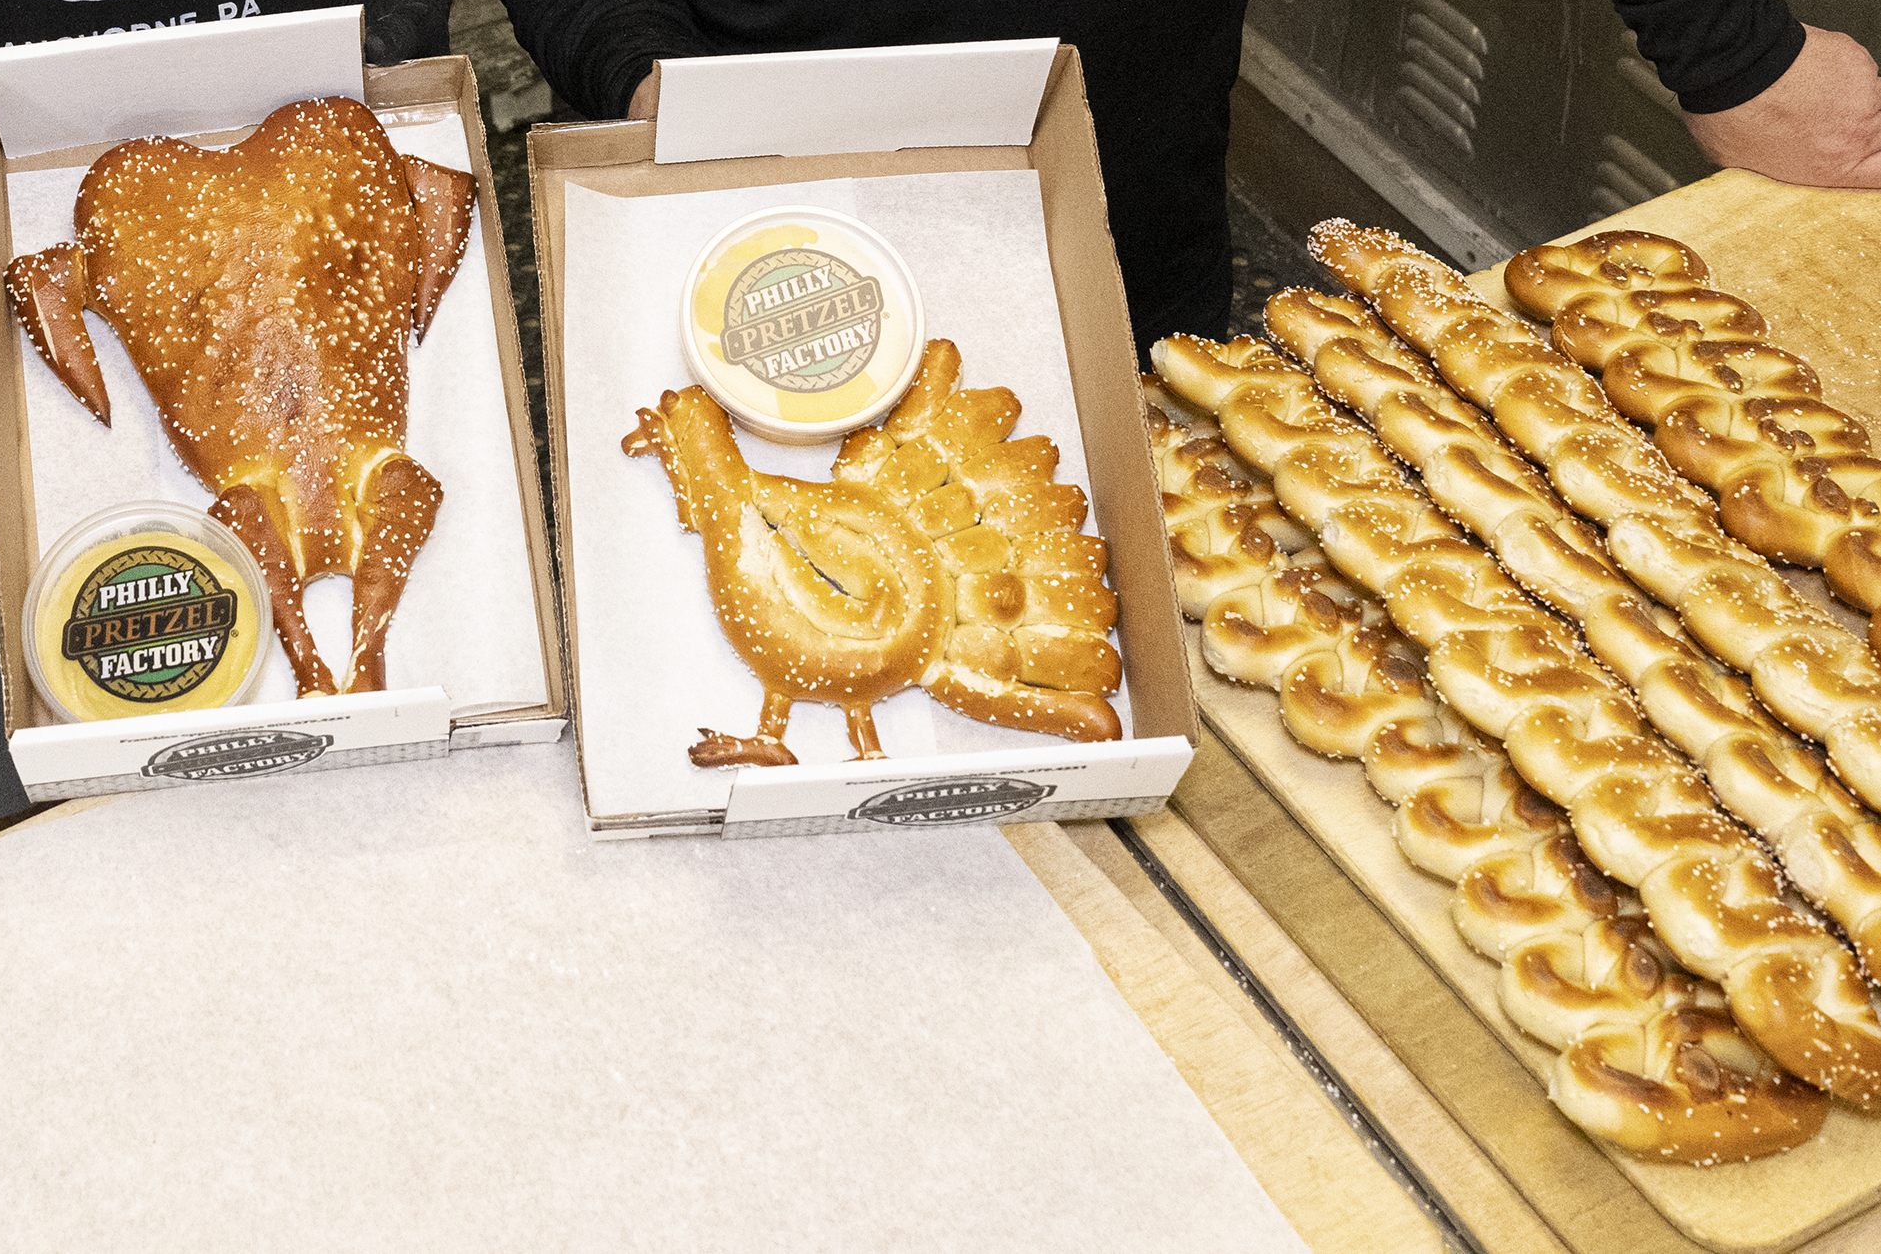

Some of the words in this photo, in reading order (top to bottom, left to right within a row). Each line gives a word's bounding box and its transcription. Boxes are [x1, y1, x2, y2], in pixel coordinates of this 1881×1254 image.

[744, 265, 832, 315] PHILLY
[739, 289, 870, 353] PRETZEL
[763, 320, 874, 379] FACTORY
[99, 570, 193, 609] PHILLY
[85, 601, 221, 647] PRETZEL
[100, 636, 218, 679] FACTORY
[178, 733, 279, 758] PHILLY
[188, 751, 311, 779] FACTORY
[889, 802, 1021, 824] FACTORY
[895, 783, 1003, 802] PHILLY
